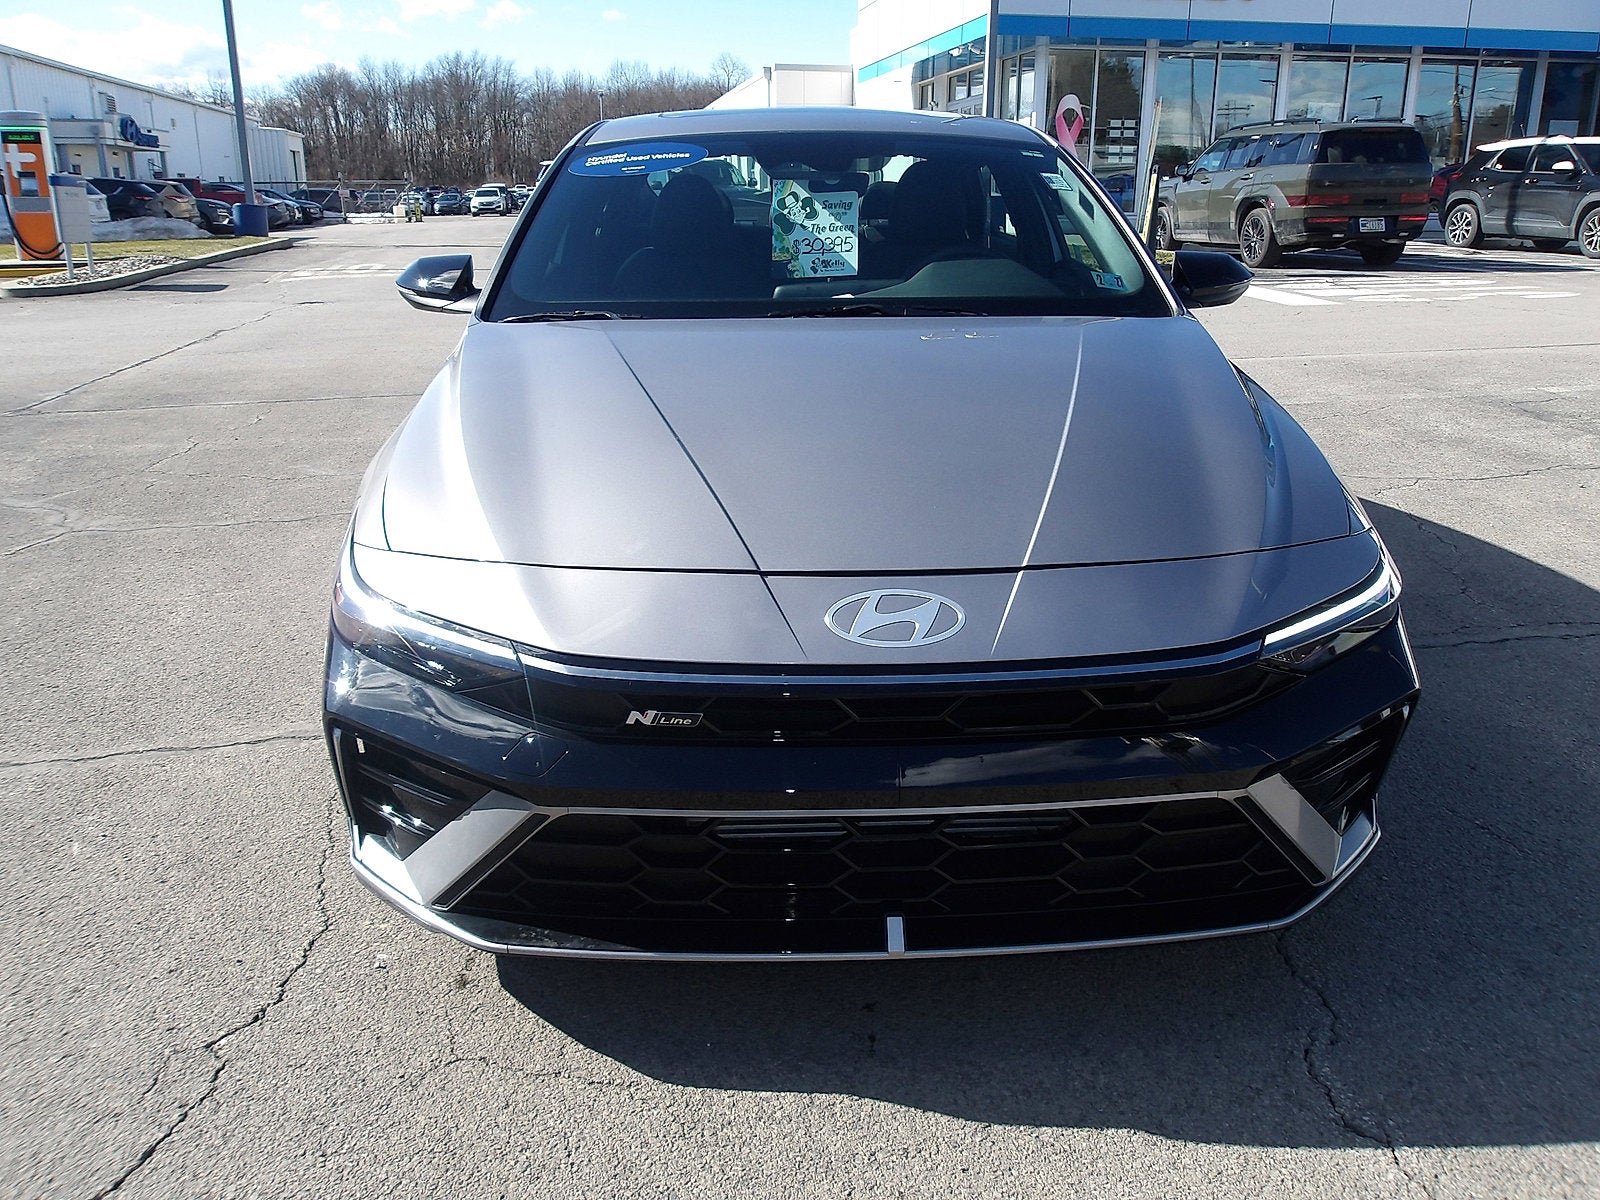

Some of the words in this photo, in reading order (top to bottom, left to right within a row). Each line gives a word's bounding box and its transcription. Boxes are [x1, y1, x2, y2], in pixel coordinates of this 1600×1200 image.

[626, 154, 651, 162] Used
[822, 200, 853, 211] Saving
[810, 223, 828, 235] The
[828, 222, 856, 233] Green
[660, 717, 692, 725] Line
